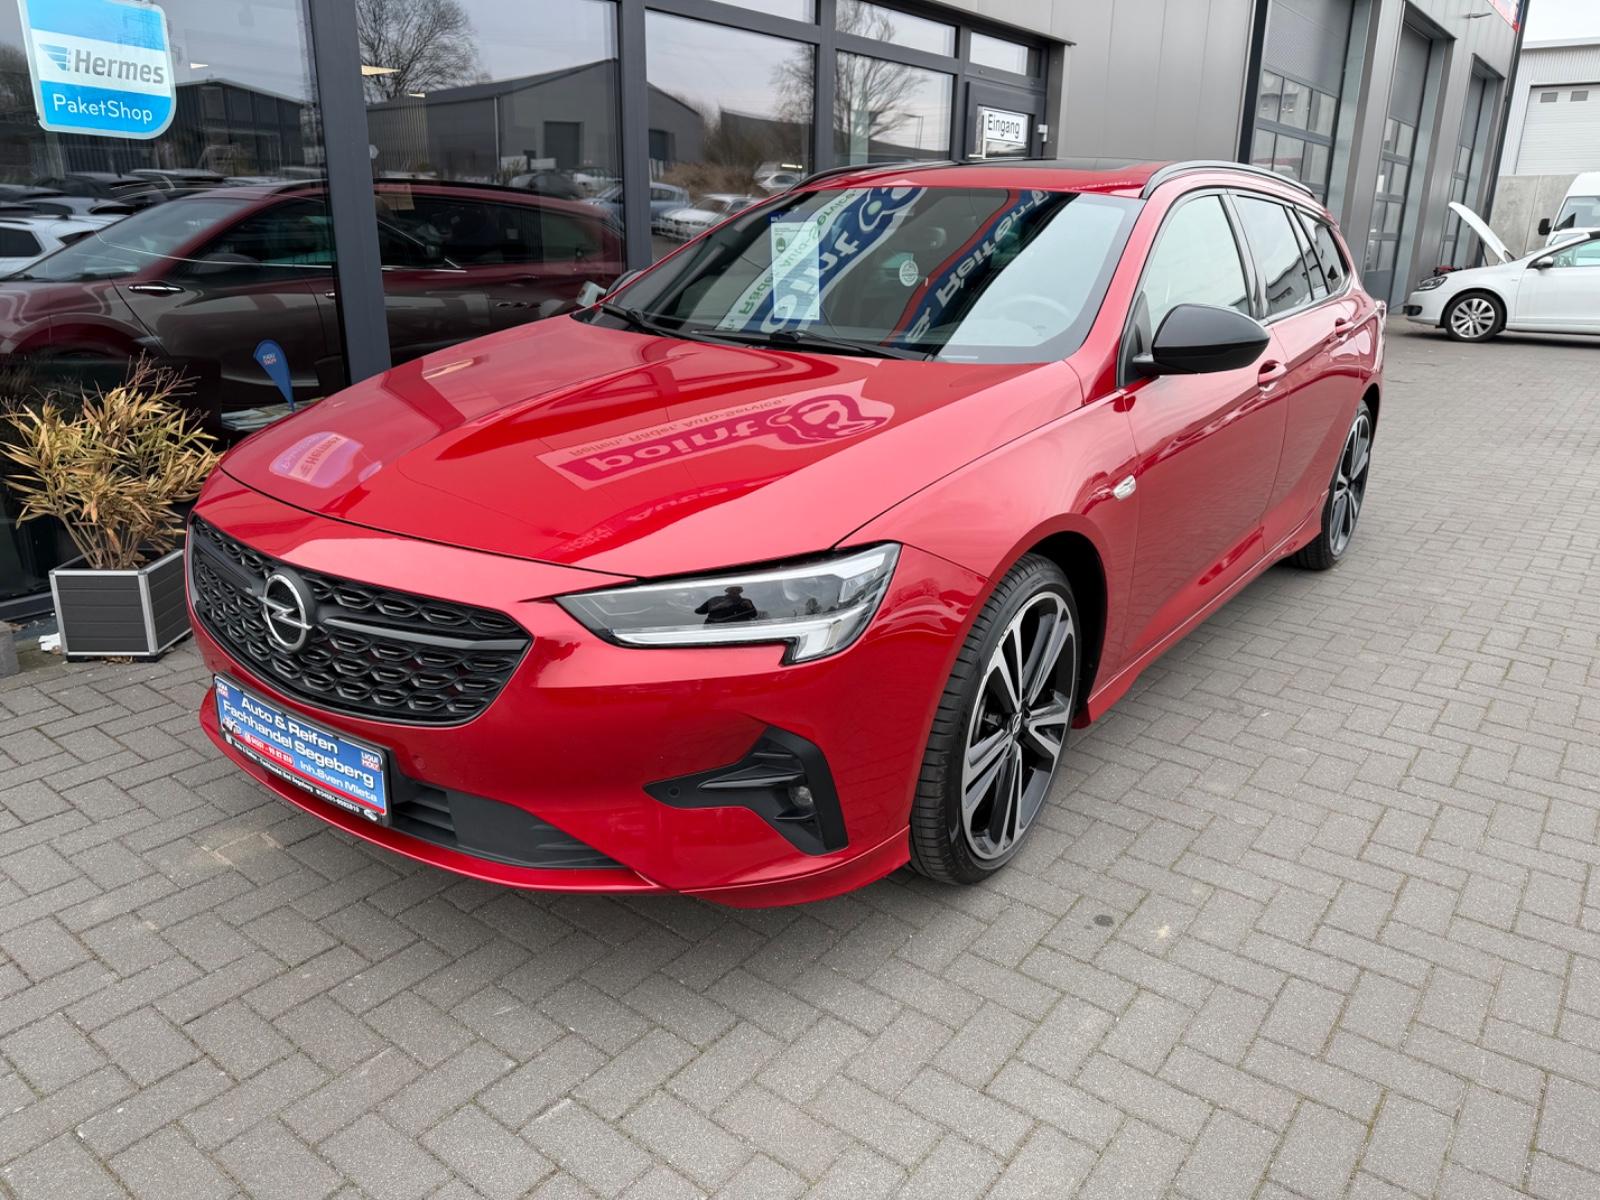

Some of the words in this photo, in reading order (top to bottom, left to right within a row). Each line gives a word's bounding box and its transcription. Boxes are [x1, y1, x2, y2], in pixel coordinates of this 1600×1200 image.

[74, 49, 165, 84] Hermes
[52, 93, 153, 124] PaketShop
[987, 113, 1020, 139] Eingang
[241, 697, 273, 723] Auto
[275, 716, 287, 731] &
[289, 721, 338, 754] Reifen
[222, 700, 293, 748] Fachhandel
[294, 740, 375, 789] Segeberg
